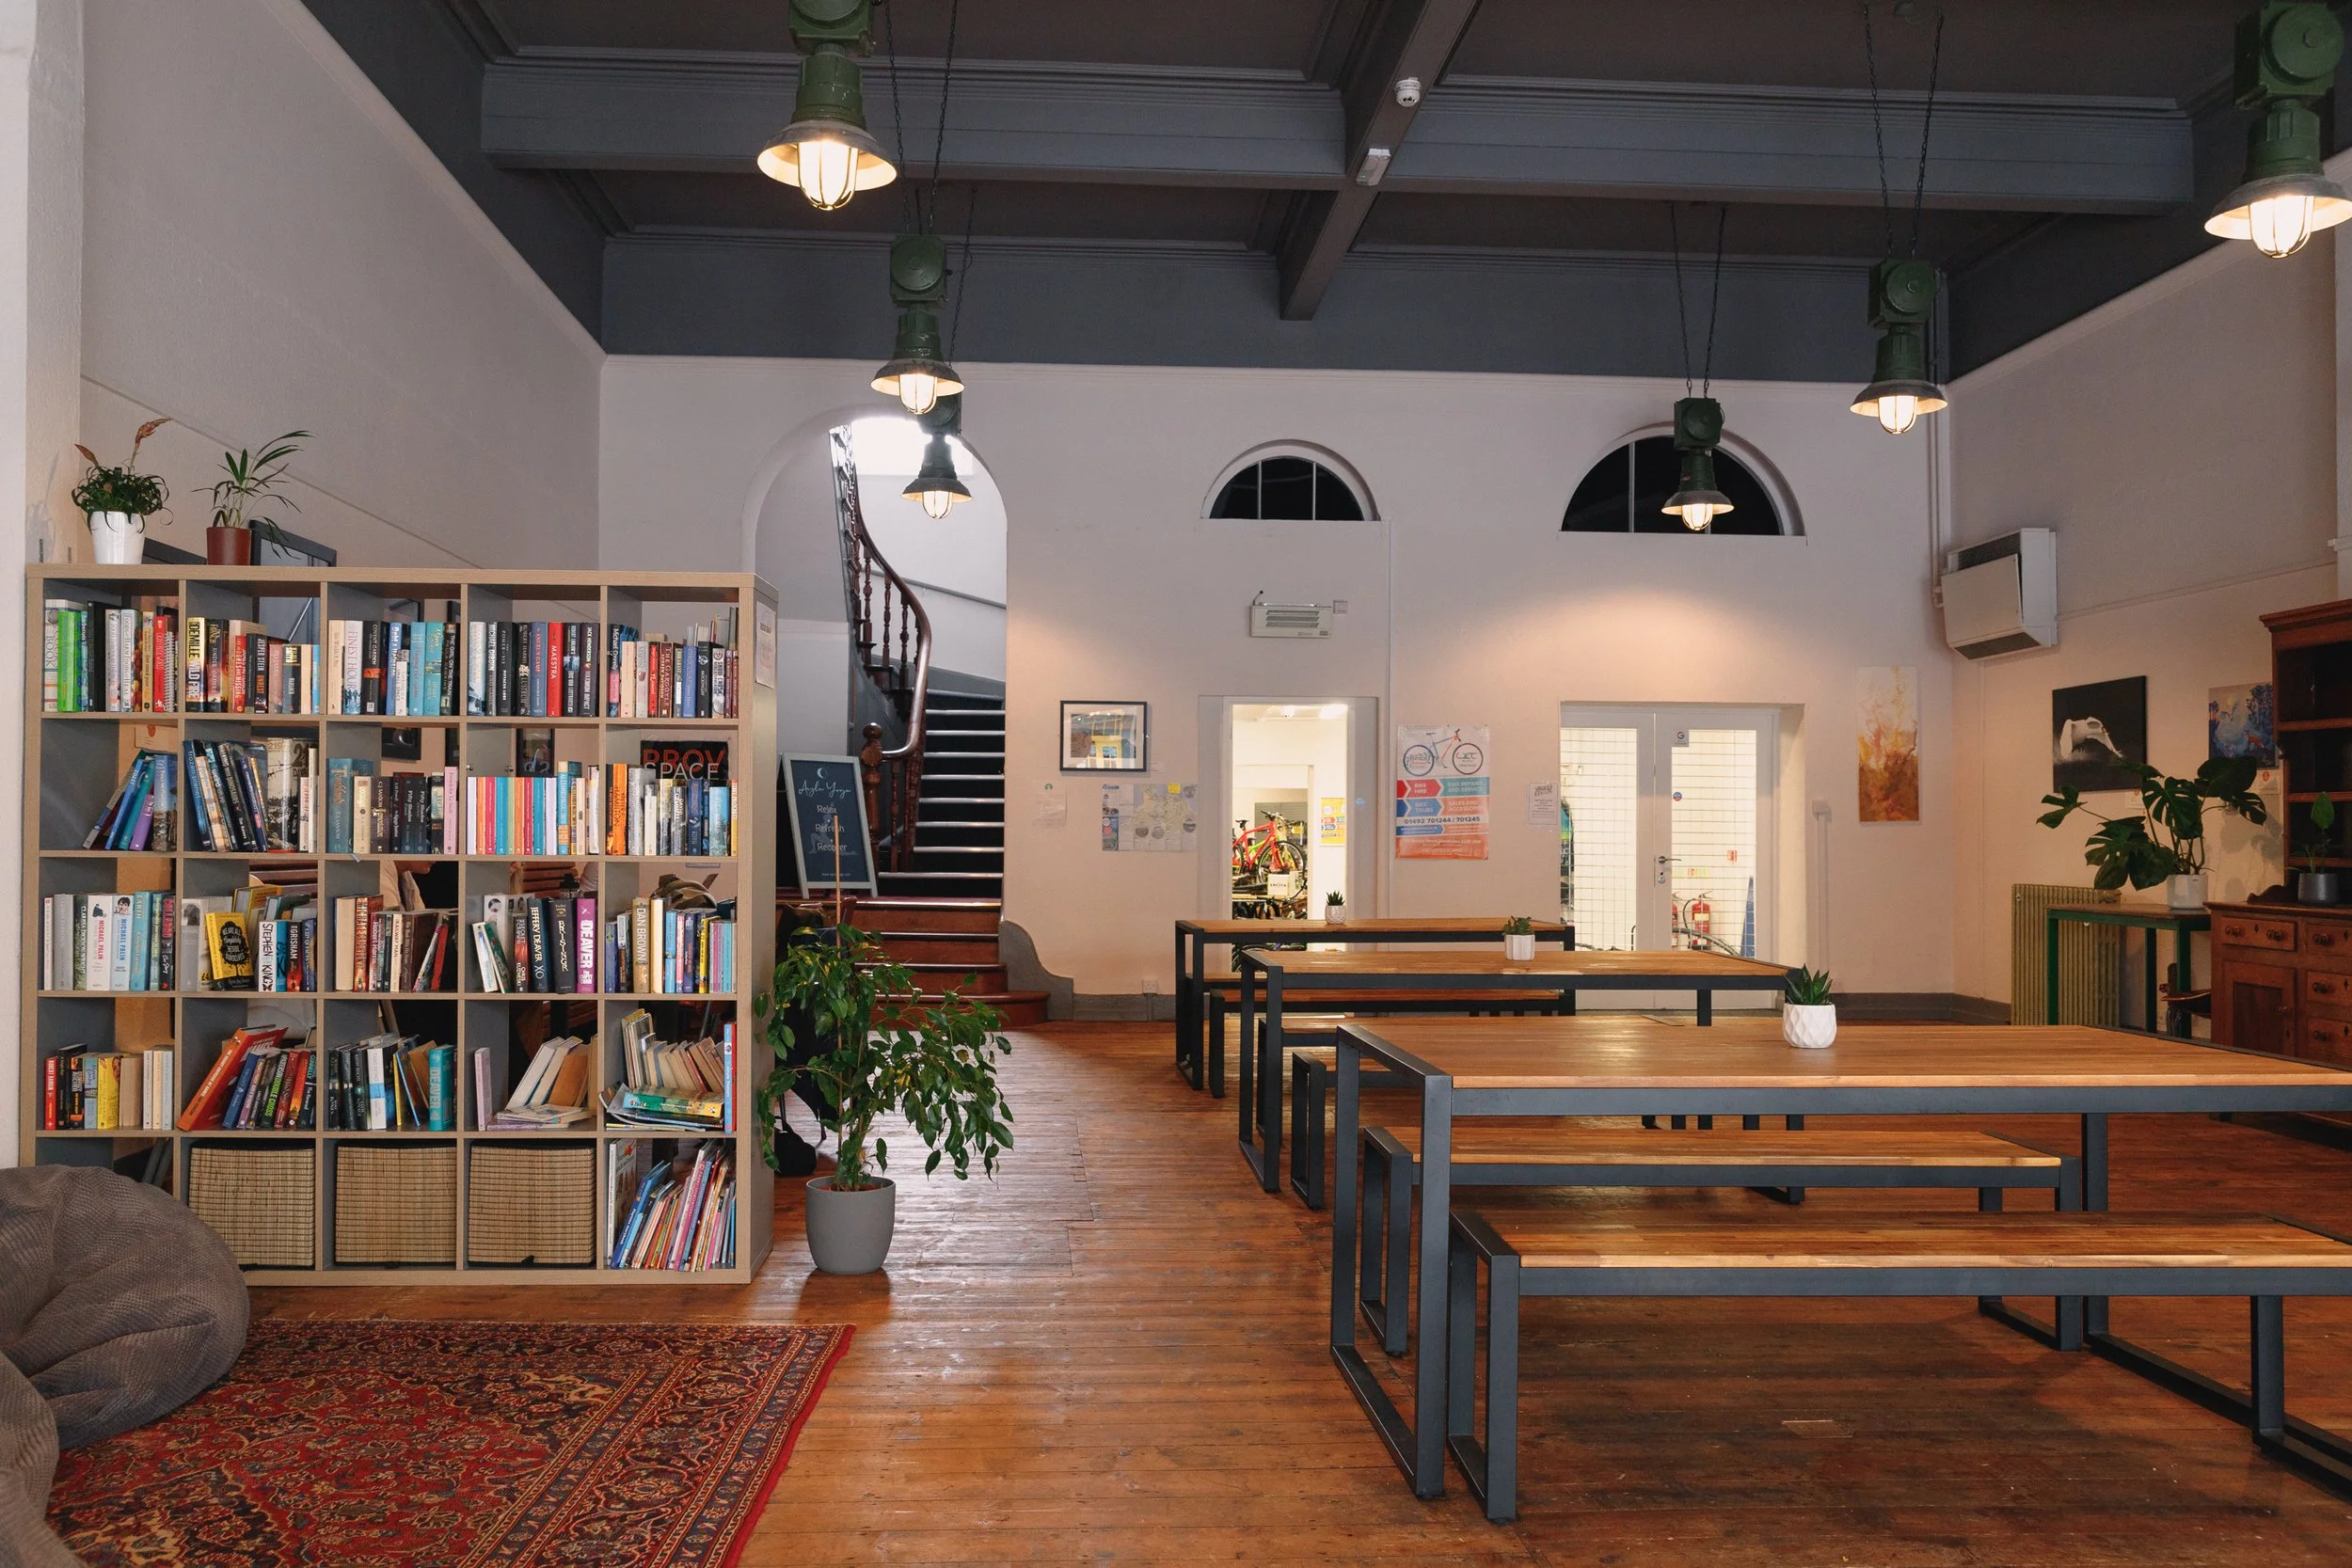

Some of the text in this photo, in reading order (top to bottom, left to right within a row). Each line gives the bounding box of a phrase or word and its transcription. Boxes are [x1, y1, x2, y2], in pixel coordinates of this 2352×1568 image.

[46, 636, 56, 667] BOOK
[187, 626, 200, 699] DEMILLE WILD FIRE
[346, 631, 358, 690] FINEST HOUR
[448, 659, 453, 669] ON
[826, 782, 851, 799] Yoga
[817, 804, 837, 814] Relax
[815, 823, 845, 833] Refreh
[817, 843, 848, 851] Recoer
[531, 907, 545, 979] JEFFERY DEAVER XO
[558, 920, 568, 971] BRISINGR
[580, 922, 593, 968] DEAVER
[636, 908, 646, 960] DAN BROWN
[262, 923, 274, 984] STEPHEN KING
[269, 1077, 282, 1100] DOUBLE
[429, 1068, 441, 1108] DEAVER
[264, 1099, 277, 1117] CROSS
